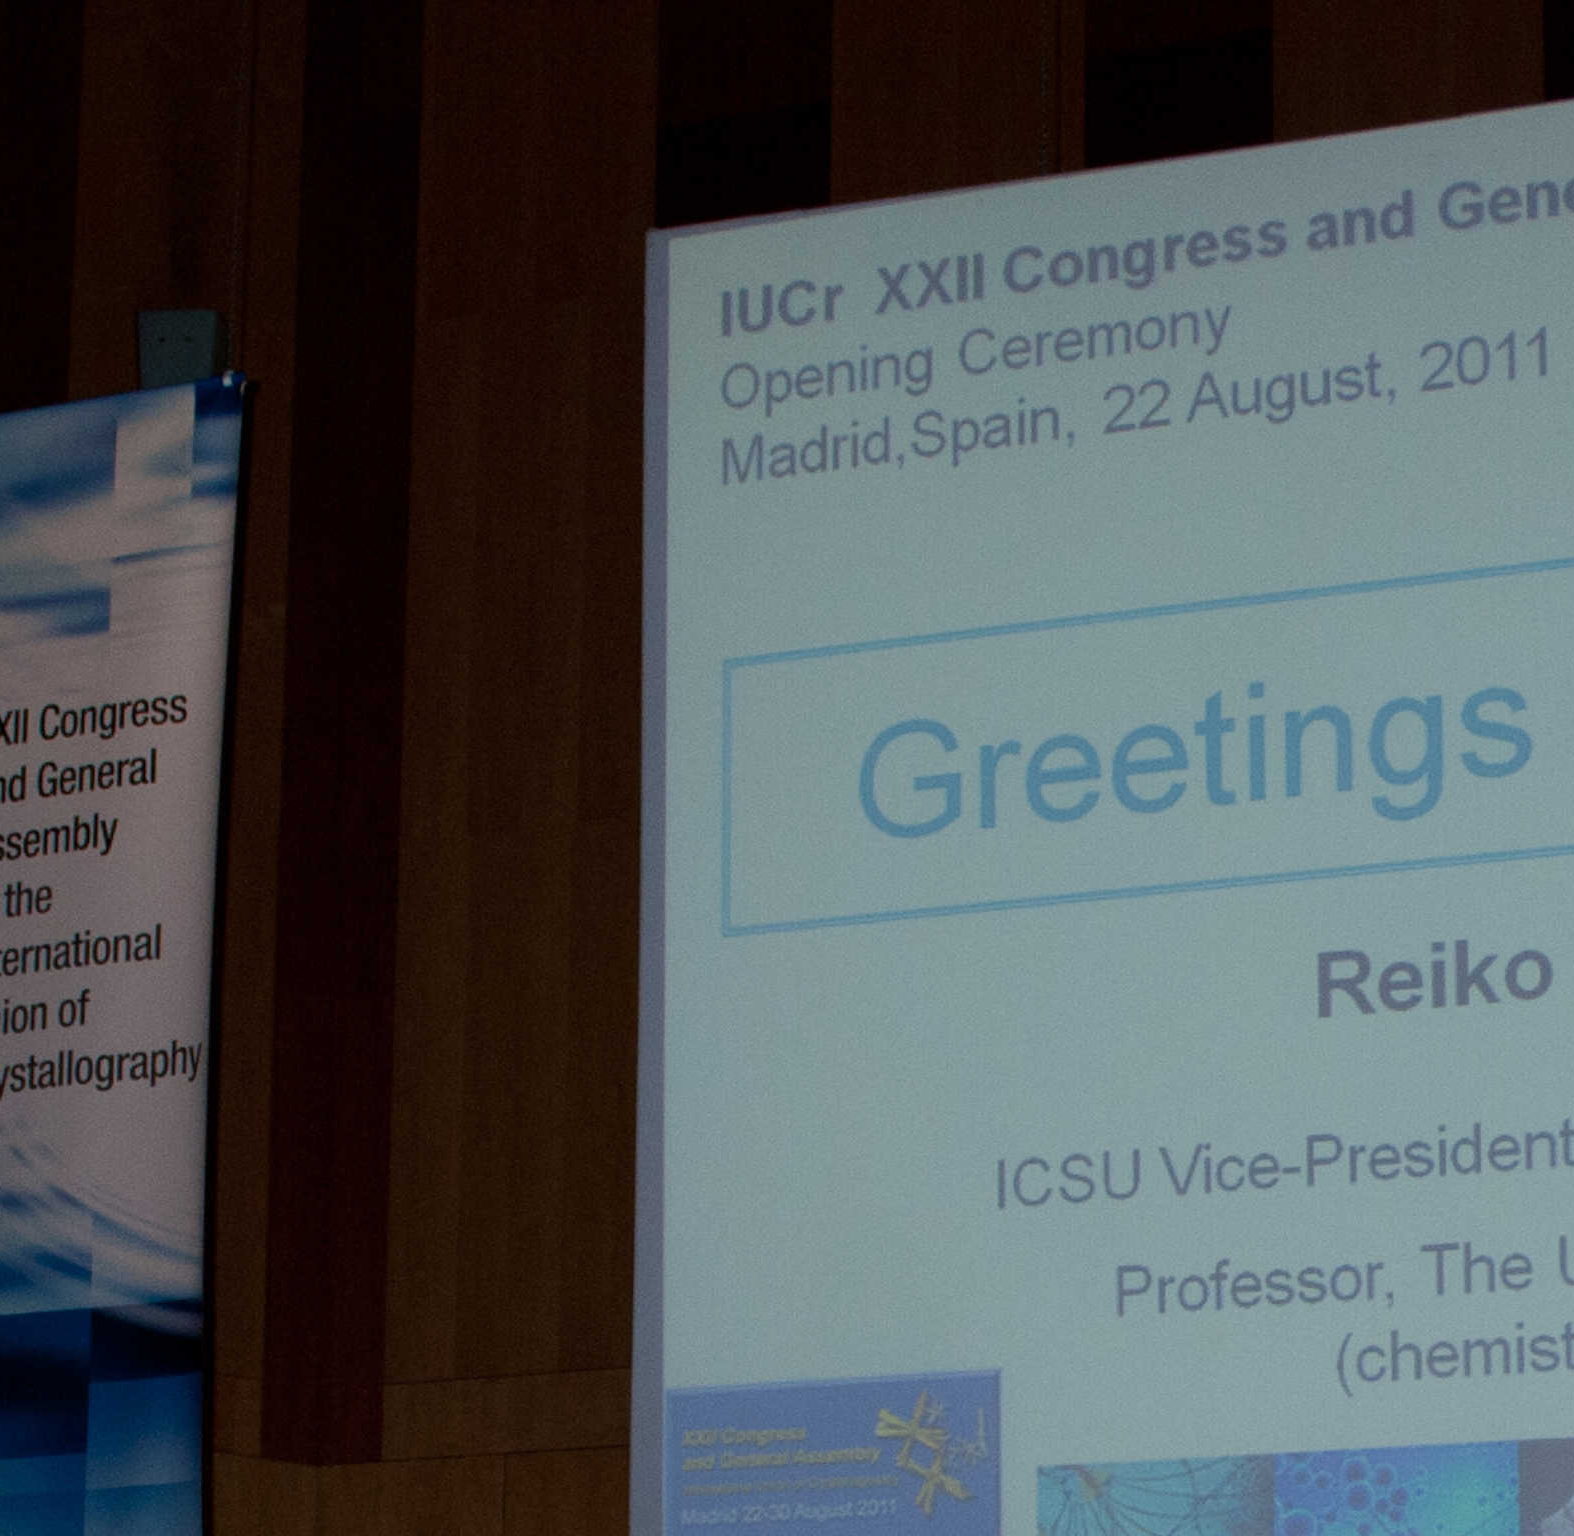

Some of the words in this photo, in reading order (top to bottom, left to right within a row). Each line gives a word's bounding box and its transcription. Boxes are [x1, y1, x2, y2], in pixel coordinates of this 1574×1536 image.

[720, 280, 843, 337] IUCr
[874, 252, 985, 316] XXII
[1003, 213, 1287, 298] Congress
[1306, 190, 1414, 252] and
[721, 342, 933, 417] Opening
[958, 304, 1232, 377] Ceremony
[1102, 380, 1171, 437] 22
[1185, 350, 1396, 426] August,
[1420, 326, 1552, 394] 2011
[39, 694, 188, 743] Congress
[38, 748, 157, 798] General
[858, 681, 1533, 839] Greetings
[3, 881, 53, 916] the
[58, 989, 91, 1028] of
[1317, 939, 1553, 1019] Reiko
[998, 1147, 1142, 1210] ICSU
[1116, 1258, 1395, 1317] Professor,
[1420, 1241, 1533, 1296] The
[857, 1499, 897, 1517] 2011
